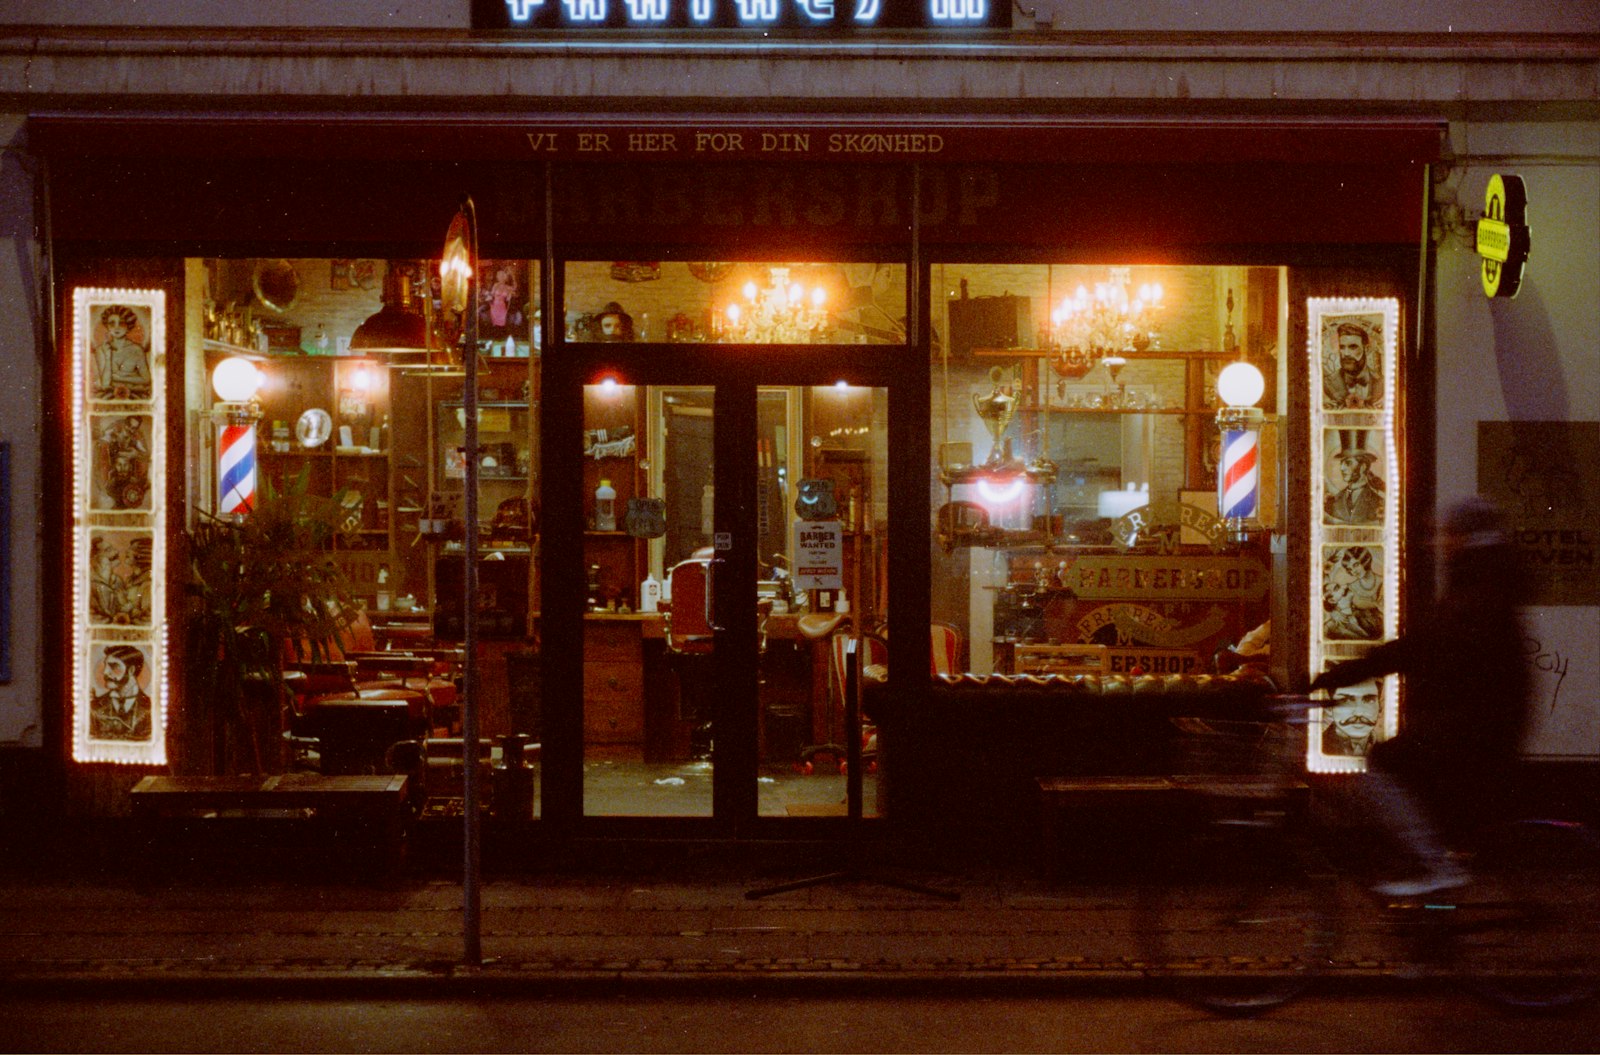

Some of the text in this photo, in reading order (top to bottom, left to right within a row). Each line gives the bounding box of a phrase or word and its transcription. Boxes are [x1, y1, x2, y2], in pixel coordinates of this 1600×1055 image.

[526, 132, 945, 154] VI ER HER FOR DIN SKØNHED
[800, 531, 836, 543] BARBER
